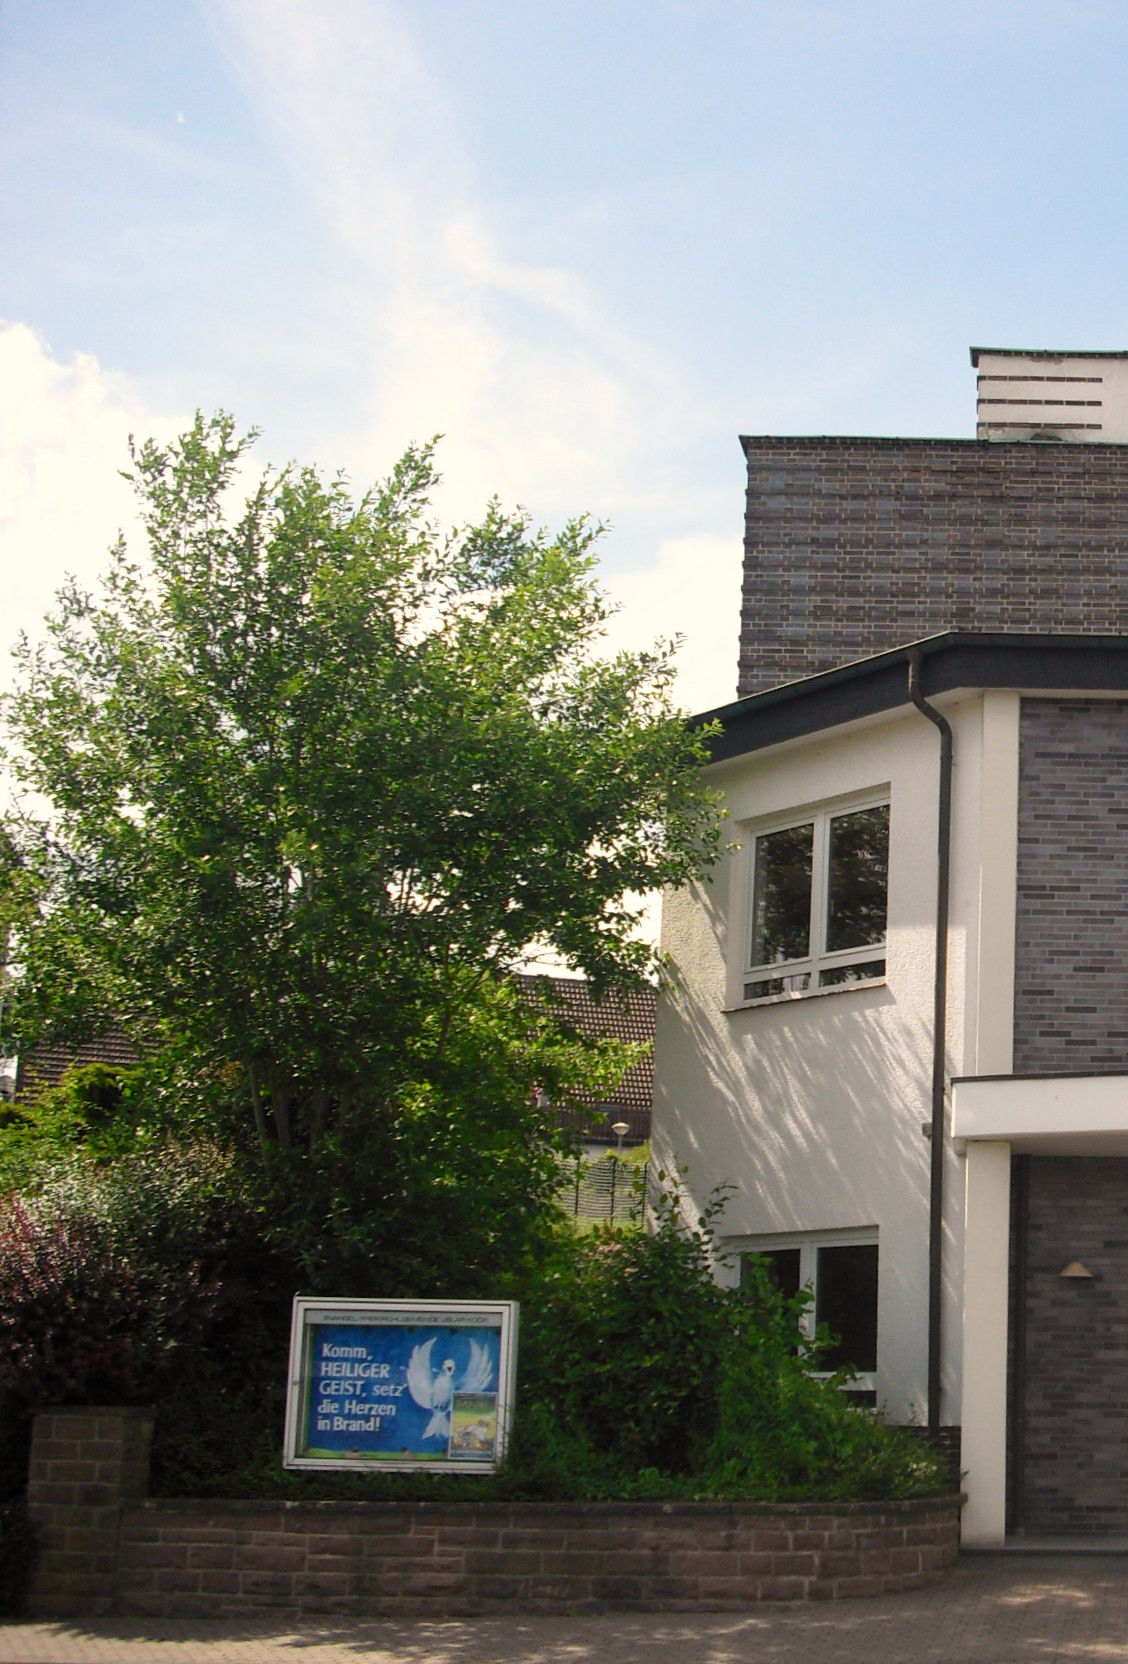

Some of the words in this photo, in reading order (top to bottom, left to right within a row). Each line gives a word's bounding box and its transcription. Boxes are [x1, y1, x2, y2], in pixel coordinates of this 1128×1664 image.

[322, 1343, 373, 1361] Komm,
[321, 1362, 389, 1378] HEILIGER
[319, 1380, 367, 1397] GEIST,
[318, 1399, 339, 1413] die
[344, 1400, 396, 1416] Herzen
[317, 1416, 330, 1430] in
[333, 1416, 380, 1431] Brand!
